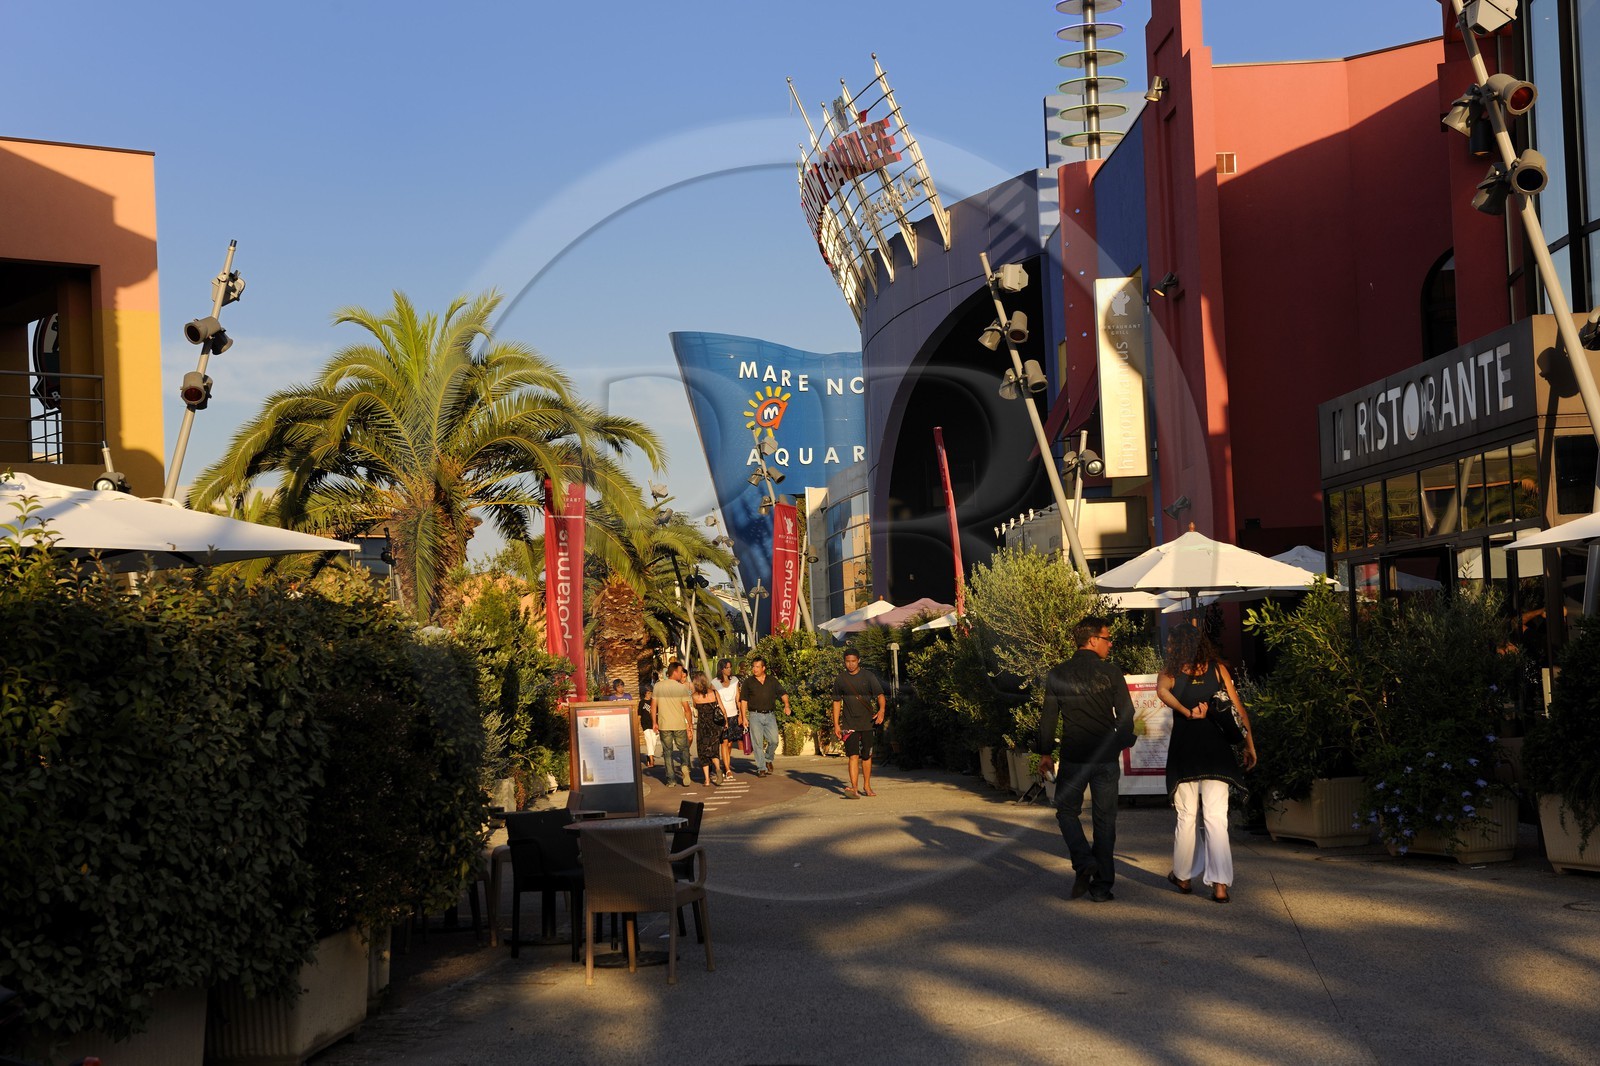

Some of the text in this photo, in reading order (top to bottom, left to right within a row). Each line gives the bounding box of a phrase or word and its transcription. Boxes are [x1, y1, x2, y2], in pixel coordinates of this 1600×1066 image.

[739, 361, 809, 392] MARE
[1117, 341, 1137, 470] hippopotamus
[1355, 341, 1514, 457] RISTORANTE
[746, 445, 866, 467] AQUAR
[780, 559, 793, 634] otamus
